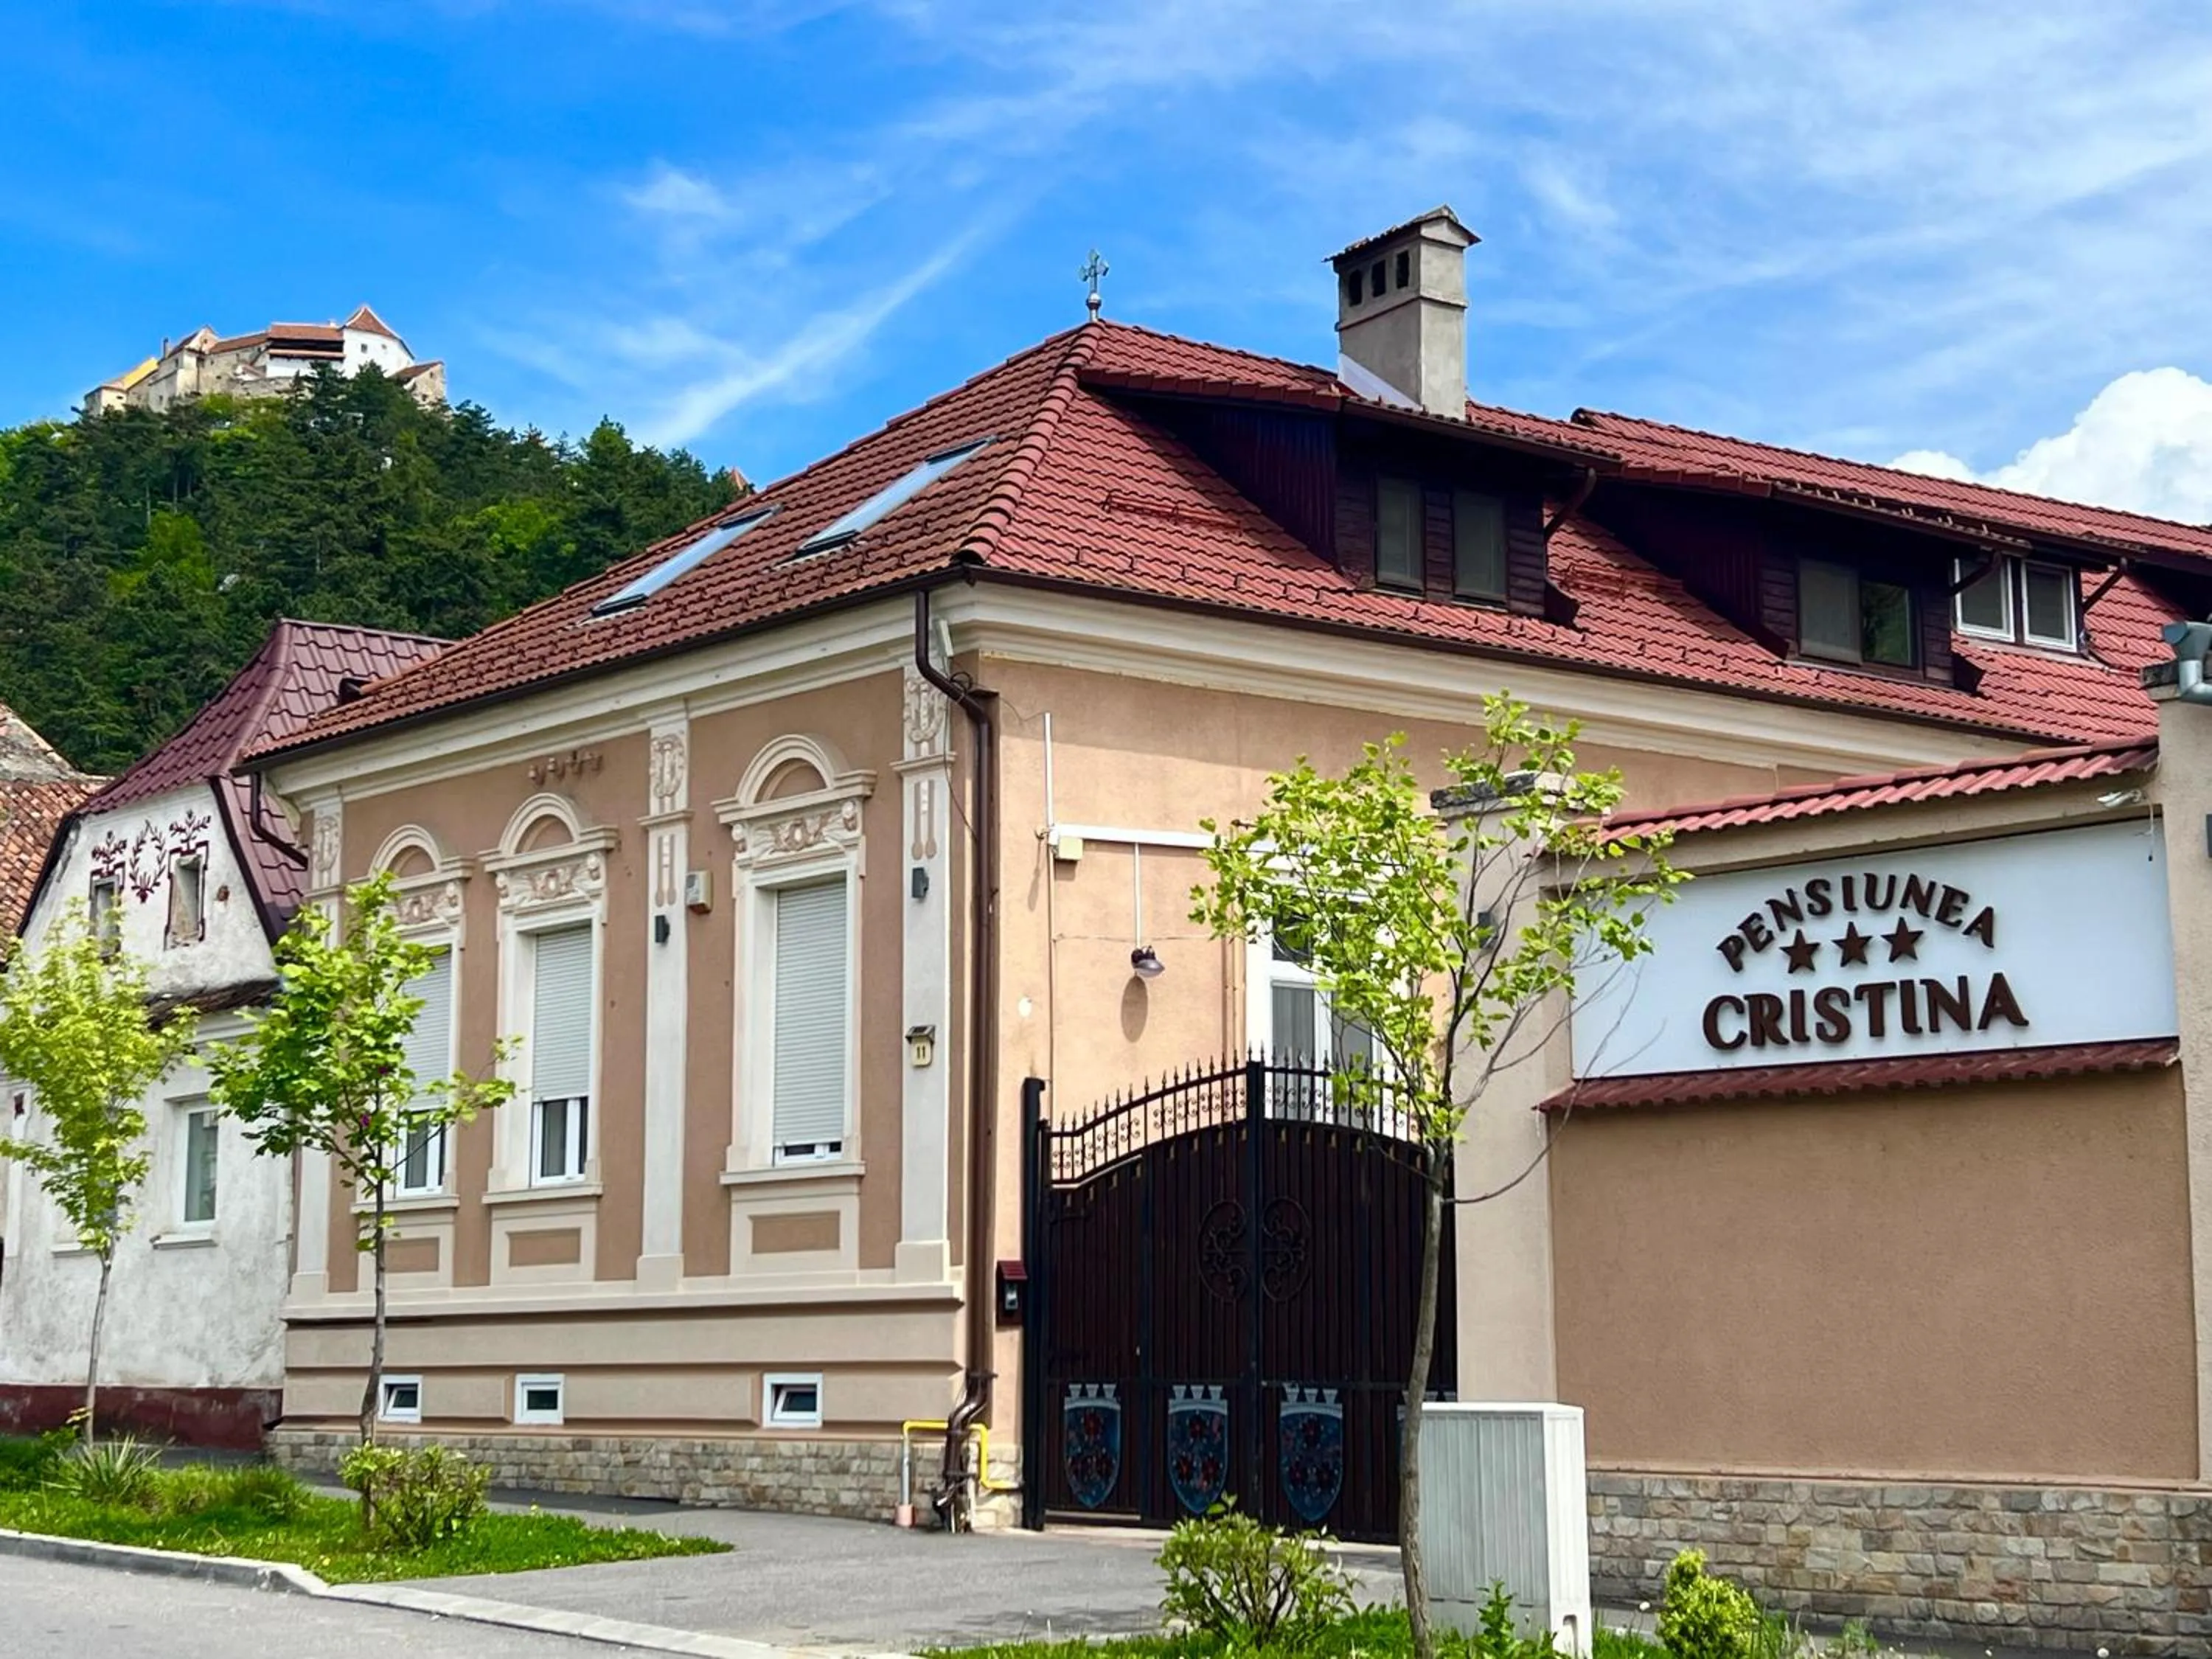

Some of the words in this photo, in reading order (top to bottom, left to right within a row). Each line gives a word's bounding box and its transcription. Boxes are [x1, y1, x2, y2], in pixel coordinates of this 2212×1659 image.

[1716, 872, 1994, 973] PENSIUNEA
[1703, 972, 2030, 1051] CRISTINA
[917, 1046, 926, 1060] 11
